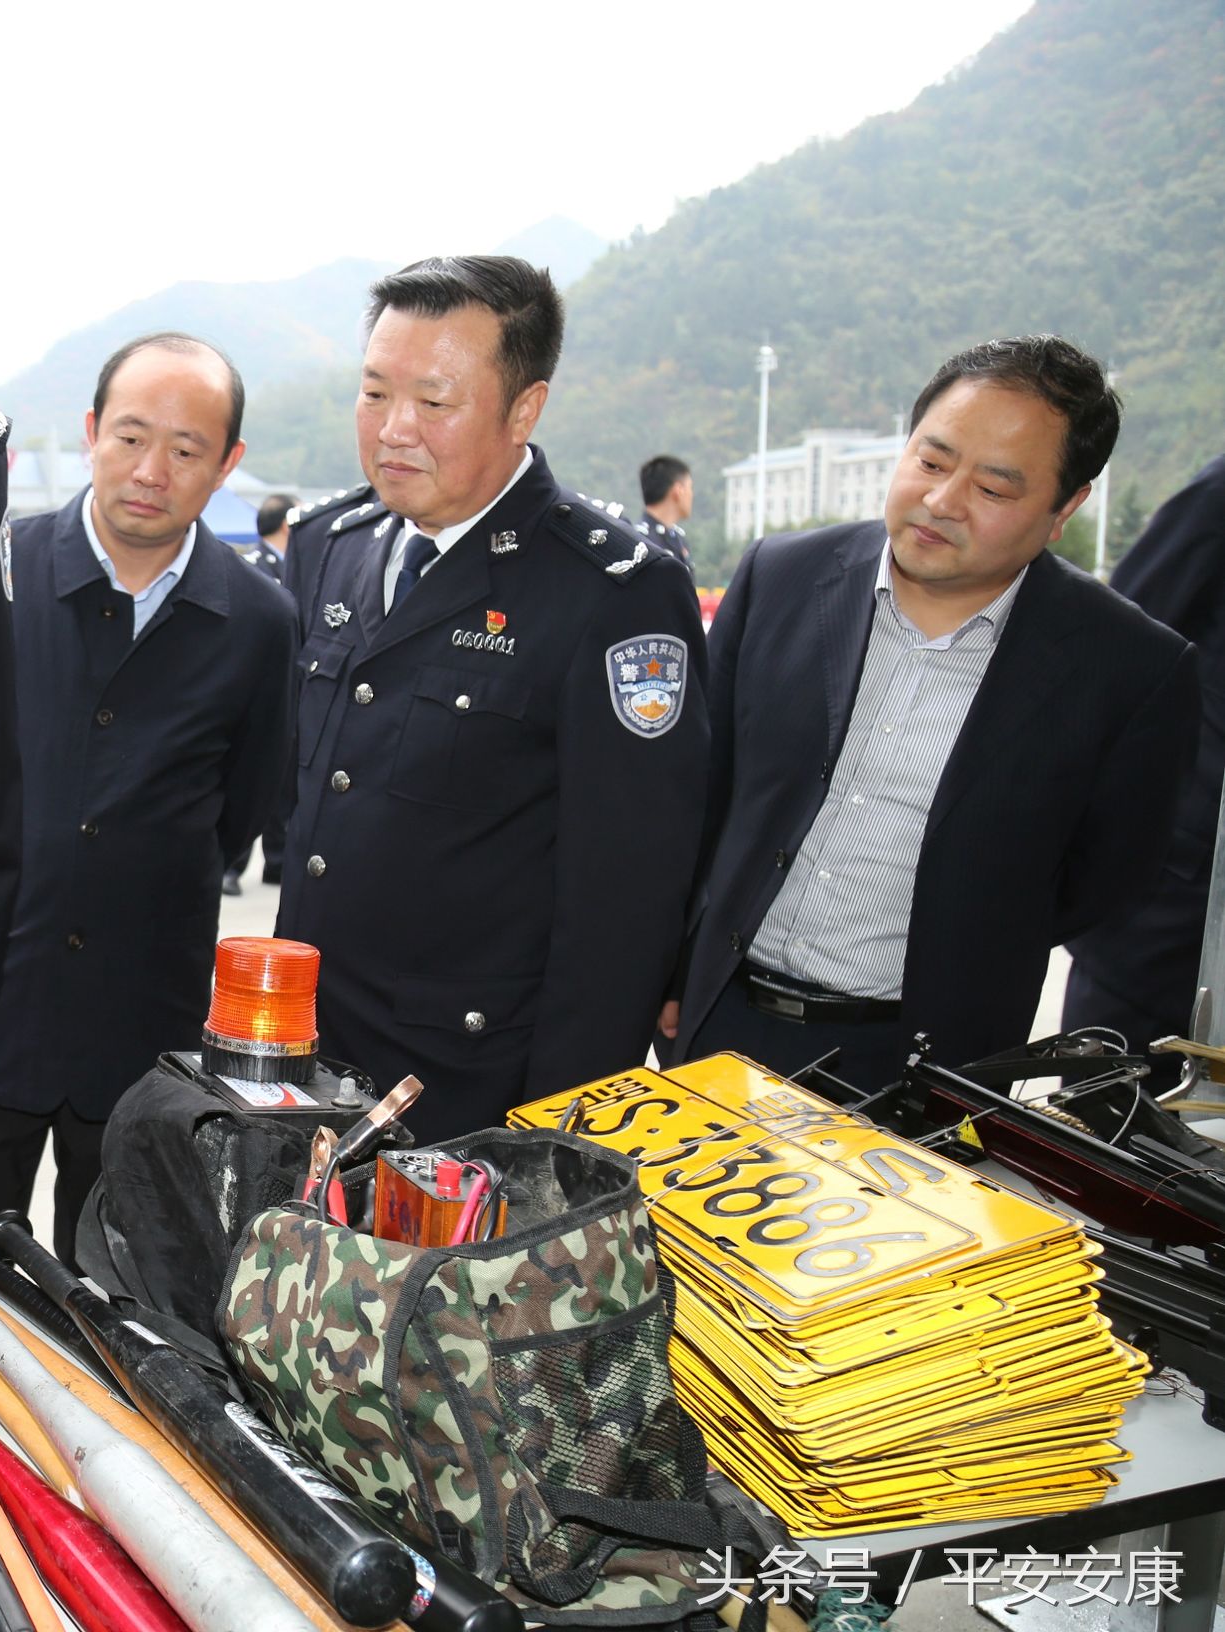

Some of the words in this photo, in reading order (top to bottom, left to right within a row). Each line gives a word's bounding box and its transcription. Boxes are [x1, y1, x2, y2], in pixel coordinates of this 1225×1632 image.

[452, 629, 515, 655] 060001
[614, 642, 682, 663] 中华人民共和国
